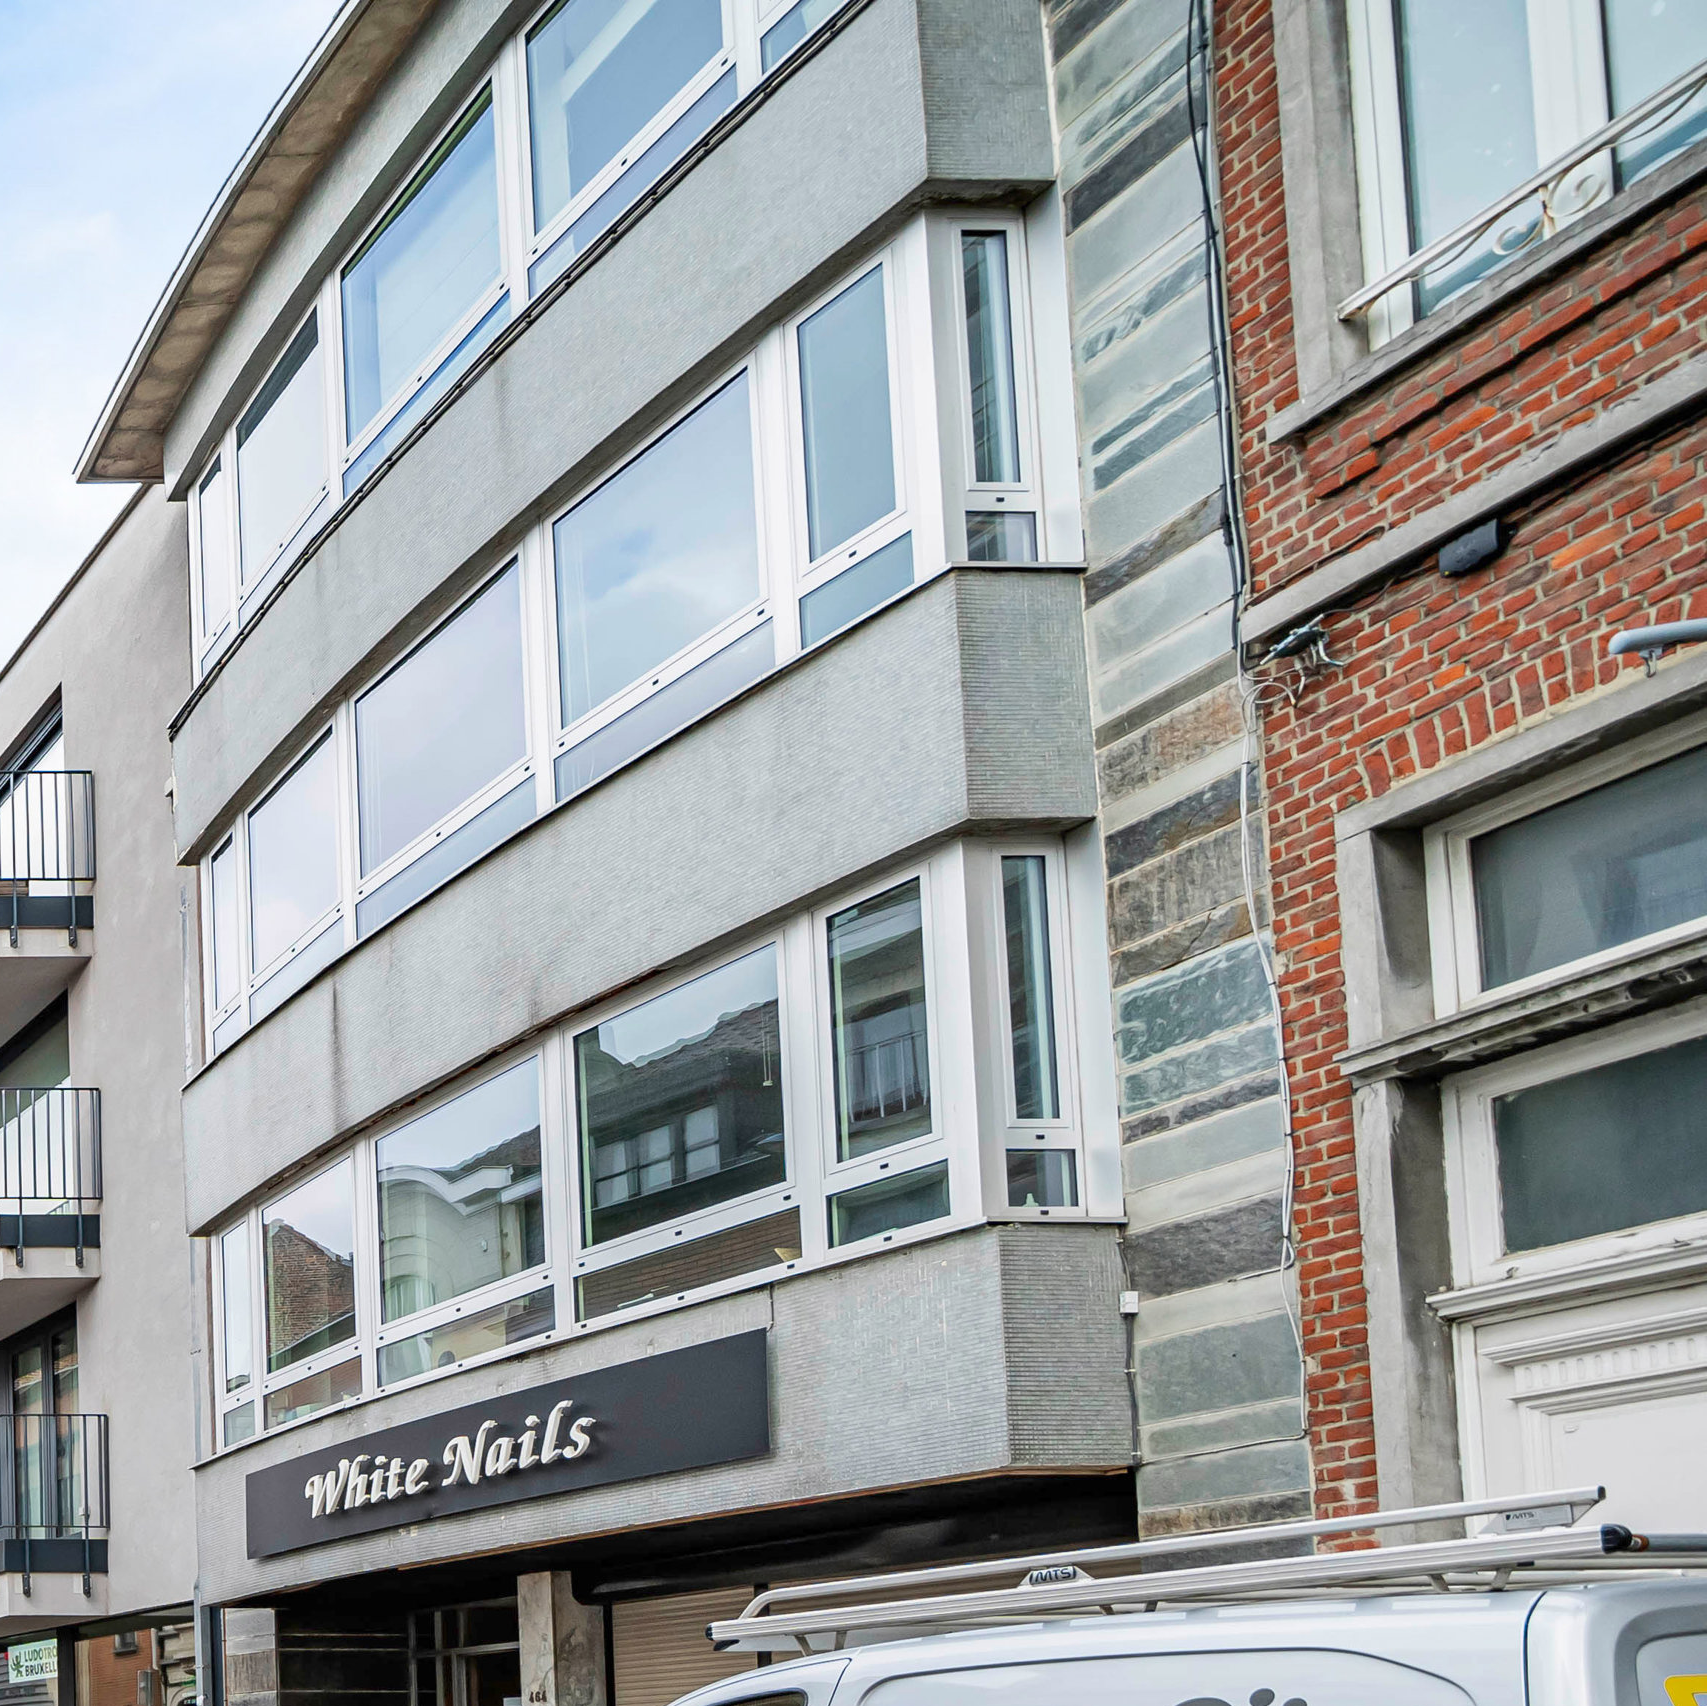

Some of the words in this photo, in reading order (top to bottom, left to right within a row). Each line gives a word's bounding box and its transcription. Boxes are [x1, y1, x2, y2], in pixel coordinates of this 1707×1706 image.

[305, 1454, 430, 1519] White
[441, 1399, 596, 1487] Nails
[1035, 1567, 1072, 1583] MTS
[24, 1646, 58, 1662] LUDOTRO
[25, 1661, 58, 1677] BRUXELL
[528, 1690, 548, 1703] 464
